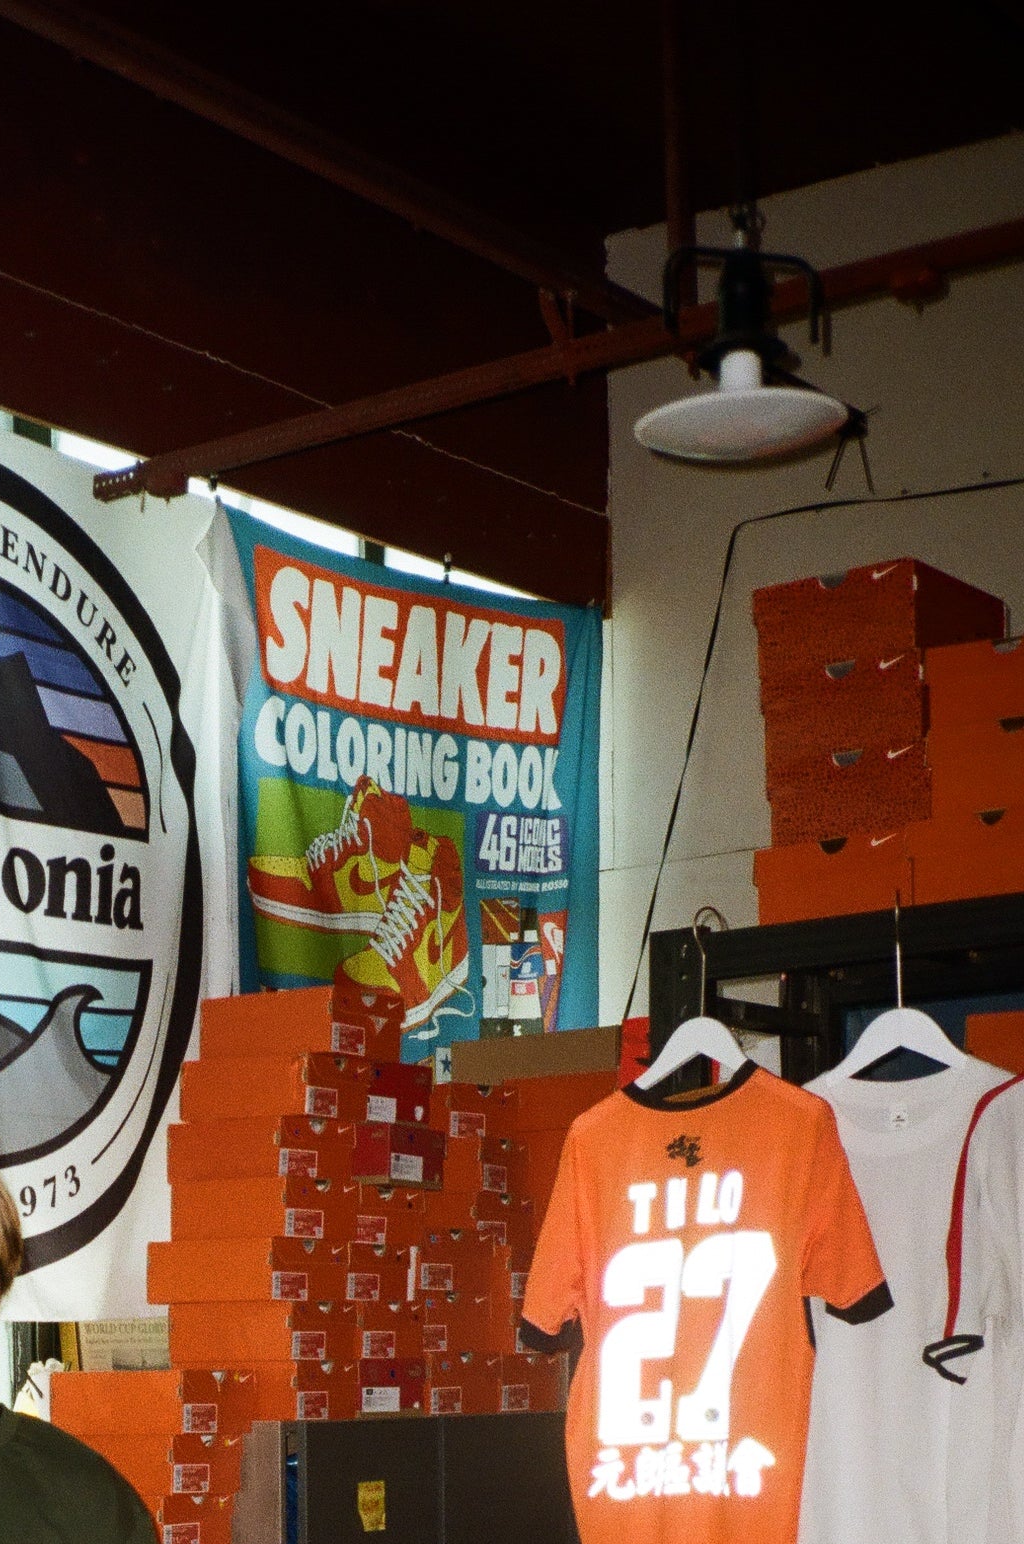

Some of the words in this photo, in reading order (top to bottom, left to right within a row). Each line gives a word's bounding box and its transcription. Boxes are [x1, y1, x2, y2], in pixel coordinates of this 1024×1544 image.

[0, 525, 138, 688] ENDURE
[265, 566, 562, 735] SNEAKER
[254, 695, 460, 801] COLORING
[465, 743, 562, 811] BOOK
[478, 813, 518, 872] 46
[19, 1165, 81, 1217] 973
[597, 1230, 777, 1446] 27
